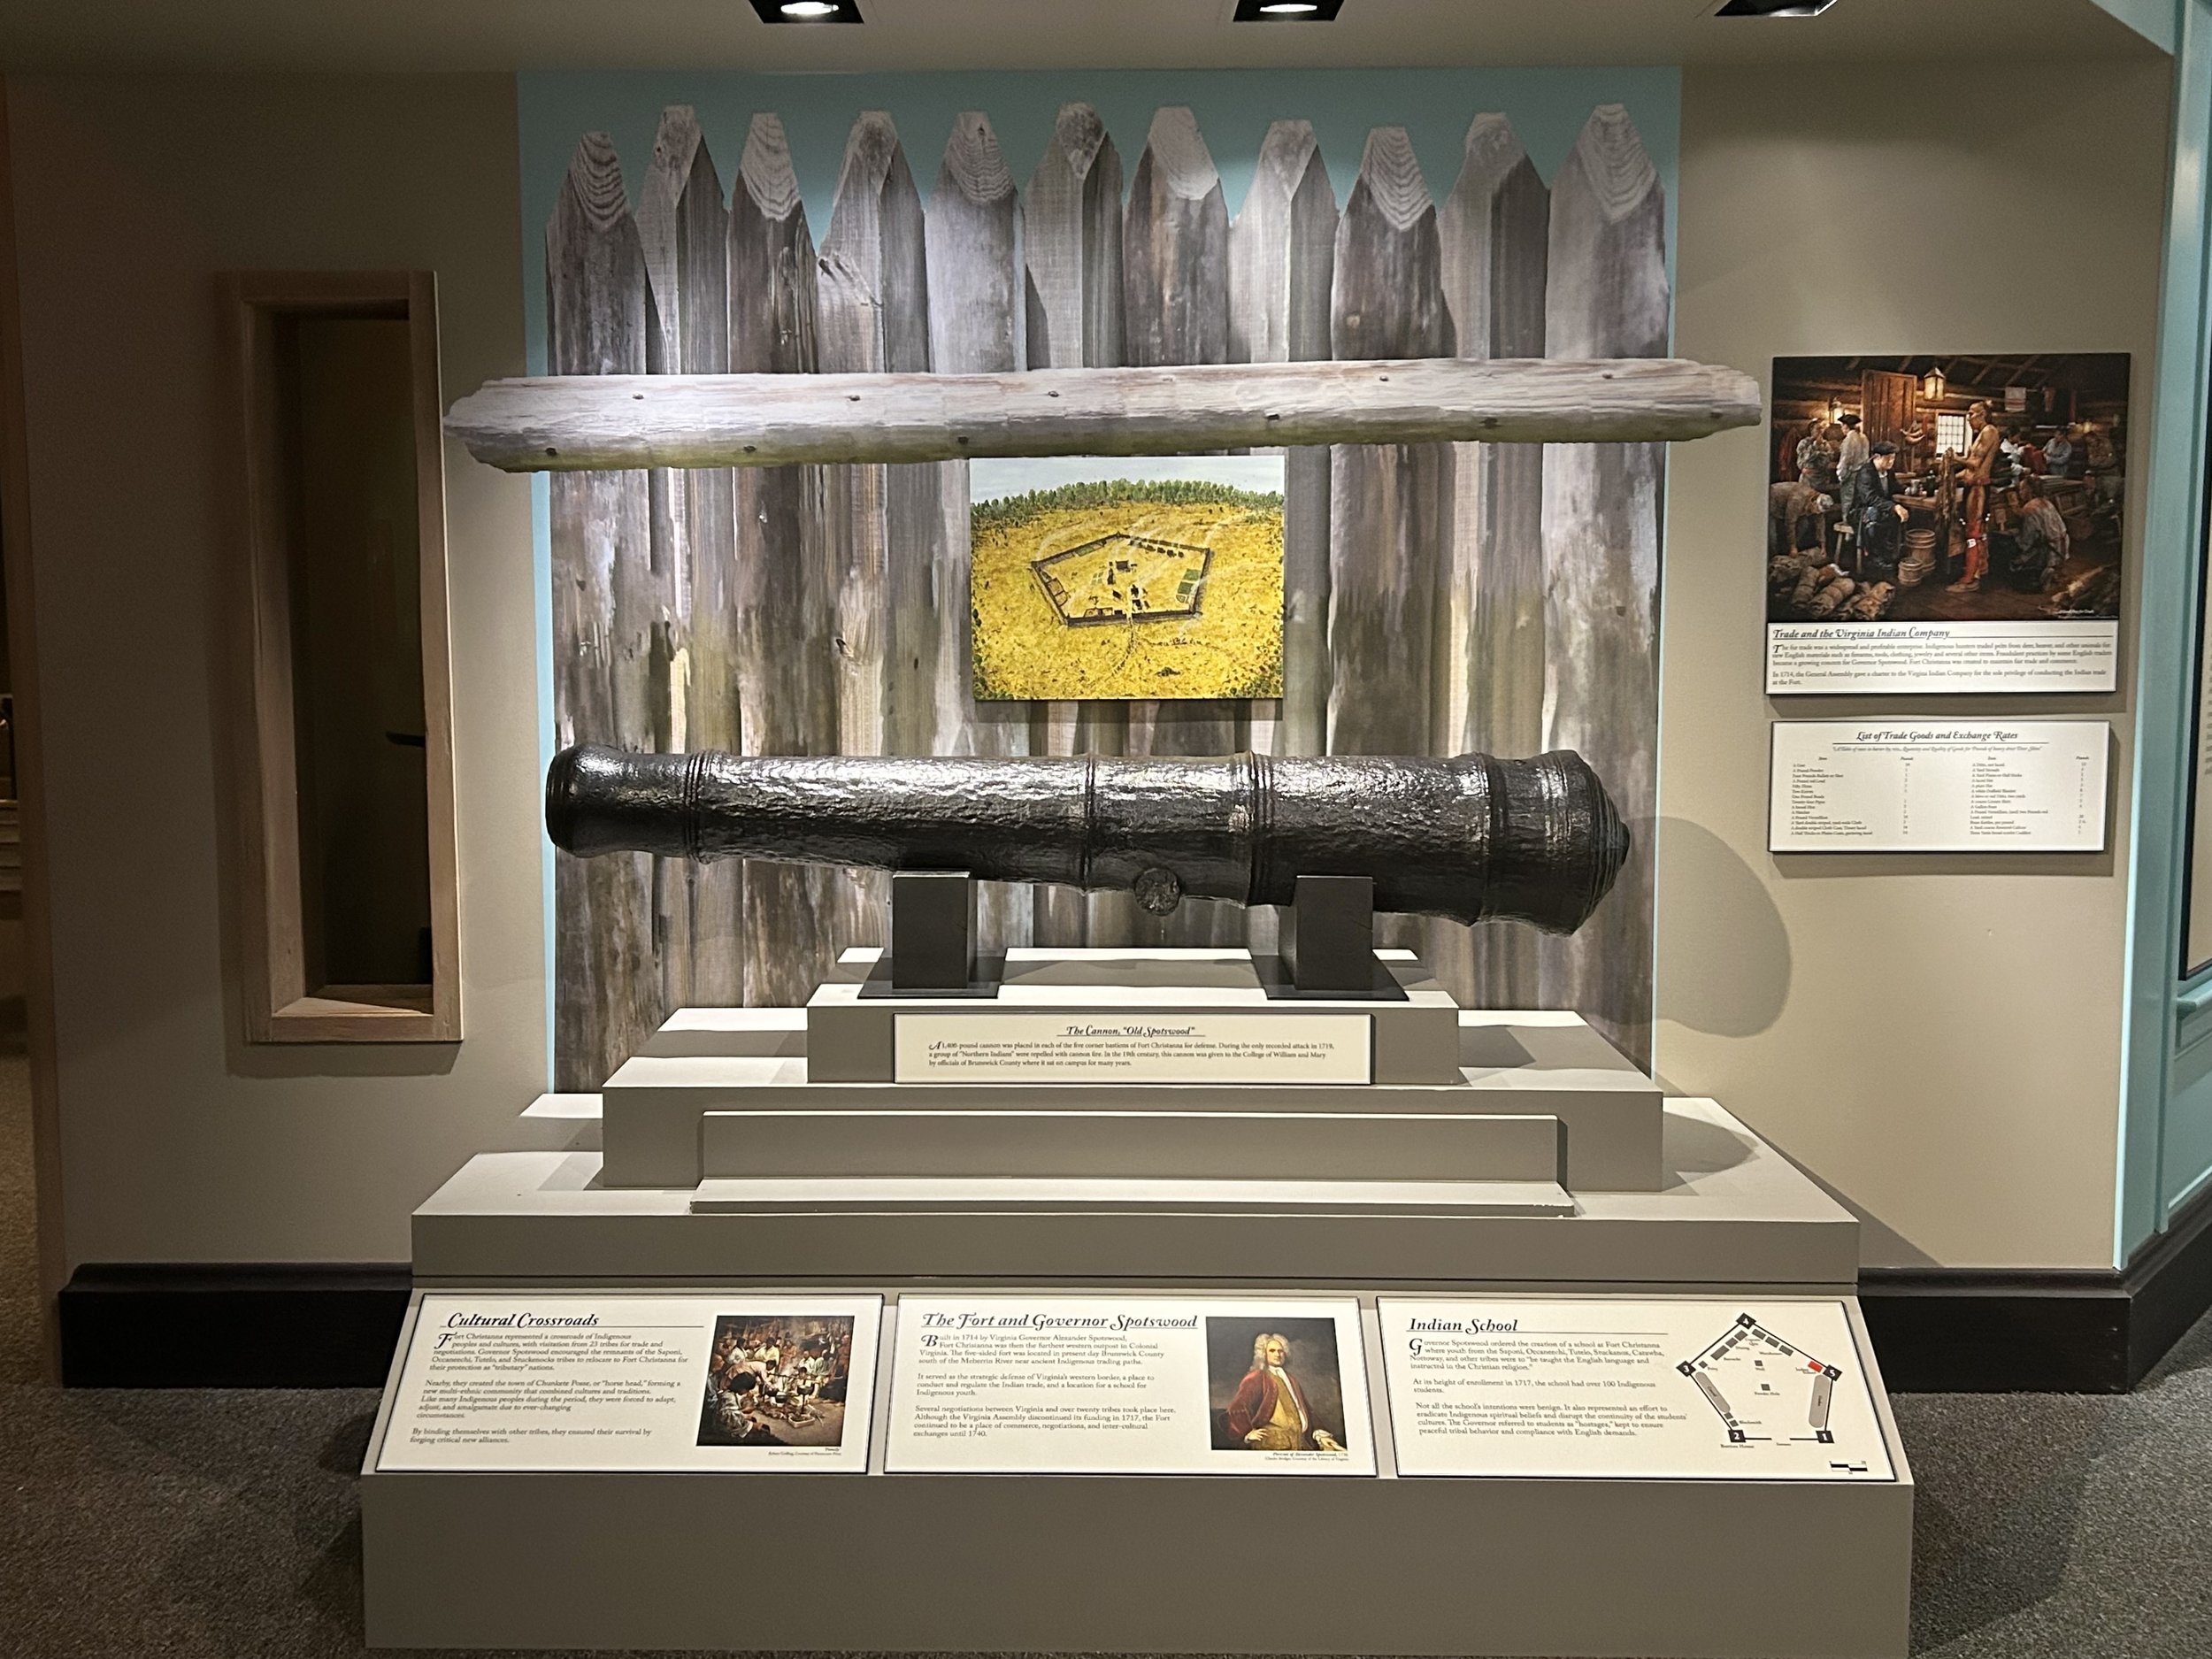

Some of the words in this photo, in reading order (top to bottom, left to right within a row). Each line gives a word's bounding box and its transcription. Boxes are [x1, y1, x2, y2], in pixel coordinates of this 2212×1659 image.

[1773, 629, 1800, 638] Trade
[1834, 629, 1875, 641] Virginia
[1877, 628, 1907, 637] Indian
[1909, 626, 1950, 639] Company
[1856, 732, 1873, 741] List
[1873, 731, 1884, 741] of
[1882, 731, 1909, 740] Trade
[1909, 731, 1935, 741] Goods
[1935, 731, 1951, 740] and
[1953, 731, 1992, 741] Exchange
[1993, 731, 2018, 741] Rates
[1066, 1025, 1084, 1035] The
[1085, 1025, 1120, 1036] Cannon,
[448, 1312, 517, 1328] Cultural
[517, 1312, 600, 1328] Crossroads
[922, 1312, 955, 1326] The
[956, 1312, 995, 1329] Fort
[998, 1314, 1029, 1326] and
[1033, 1314, 1108, 1331] Governor
[1110, 1314, 1198, 1331] Spotswood
[1409, 1318, 1462, 1331] Indian
[1465, 1318, 1518, 1334] School
[921, 1334, 950, 1347] Built
